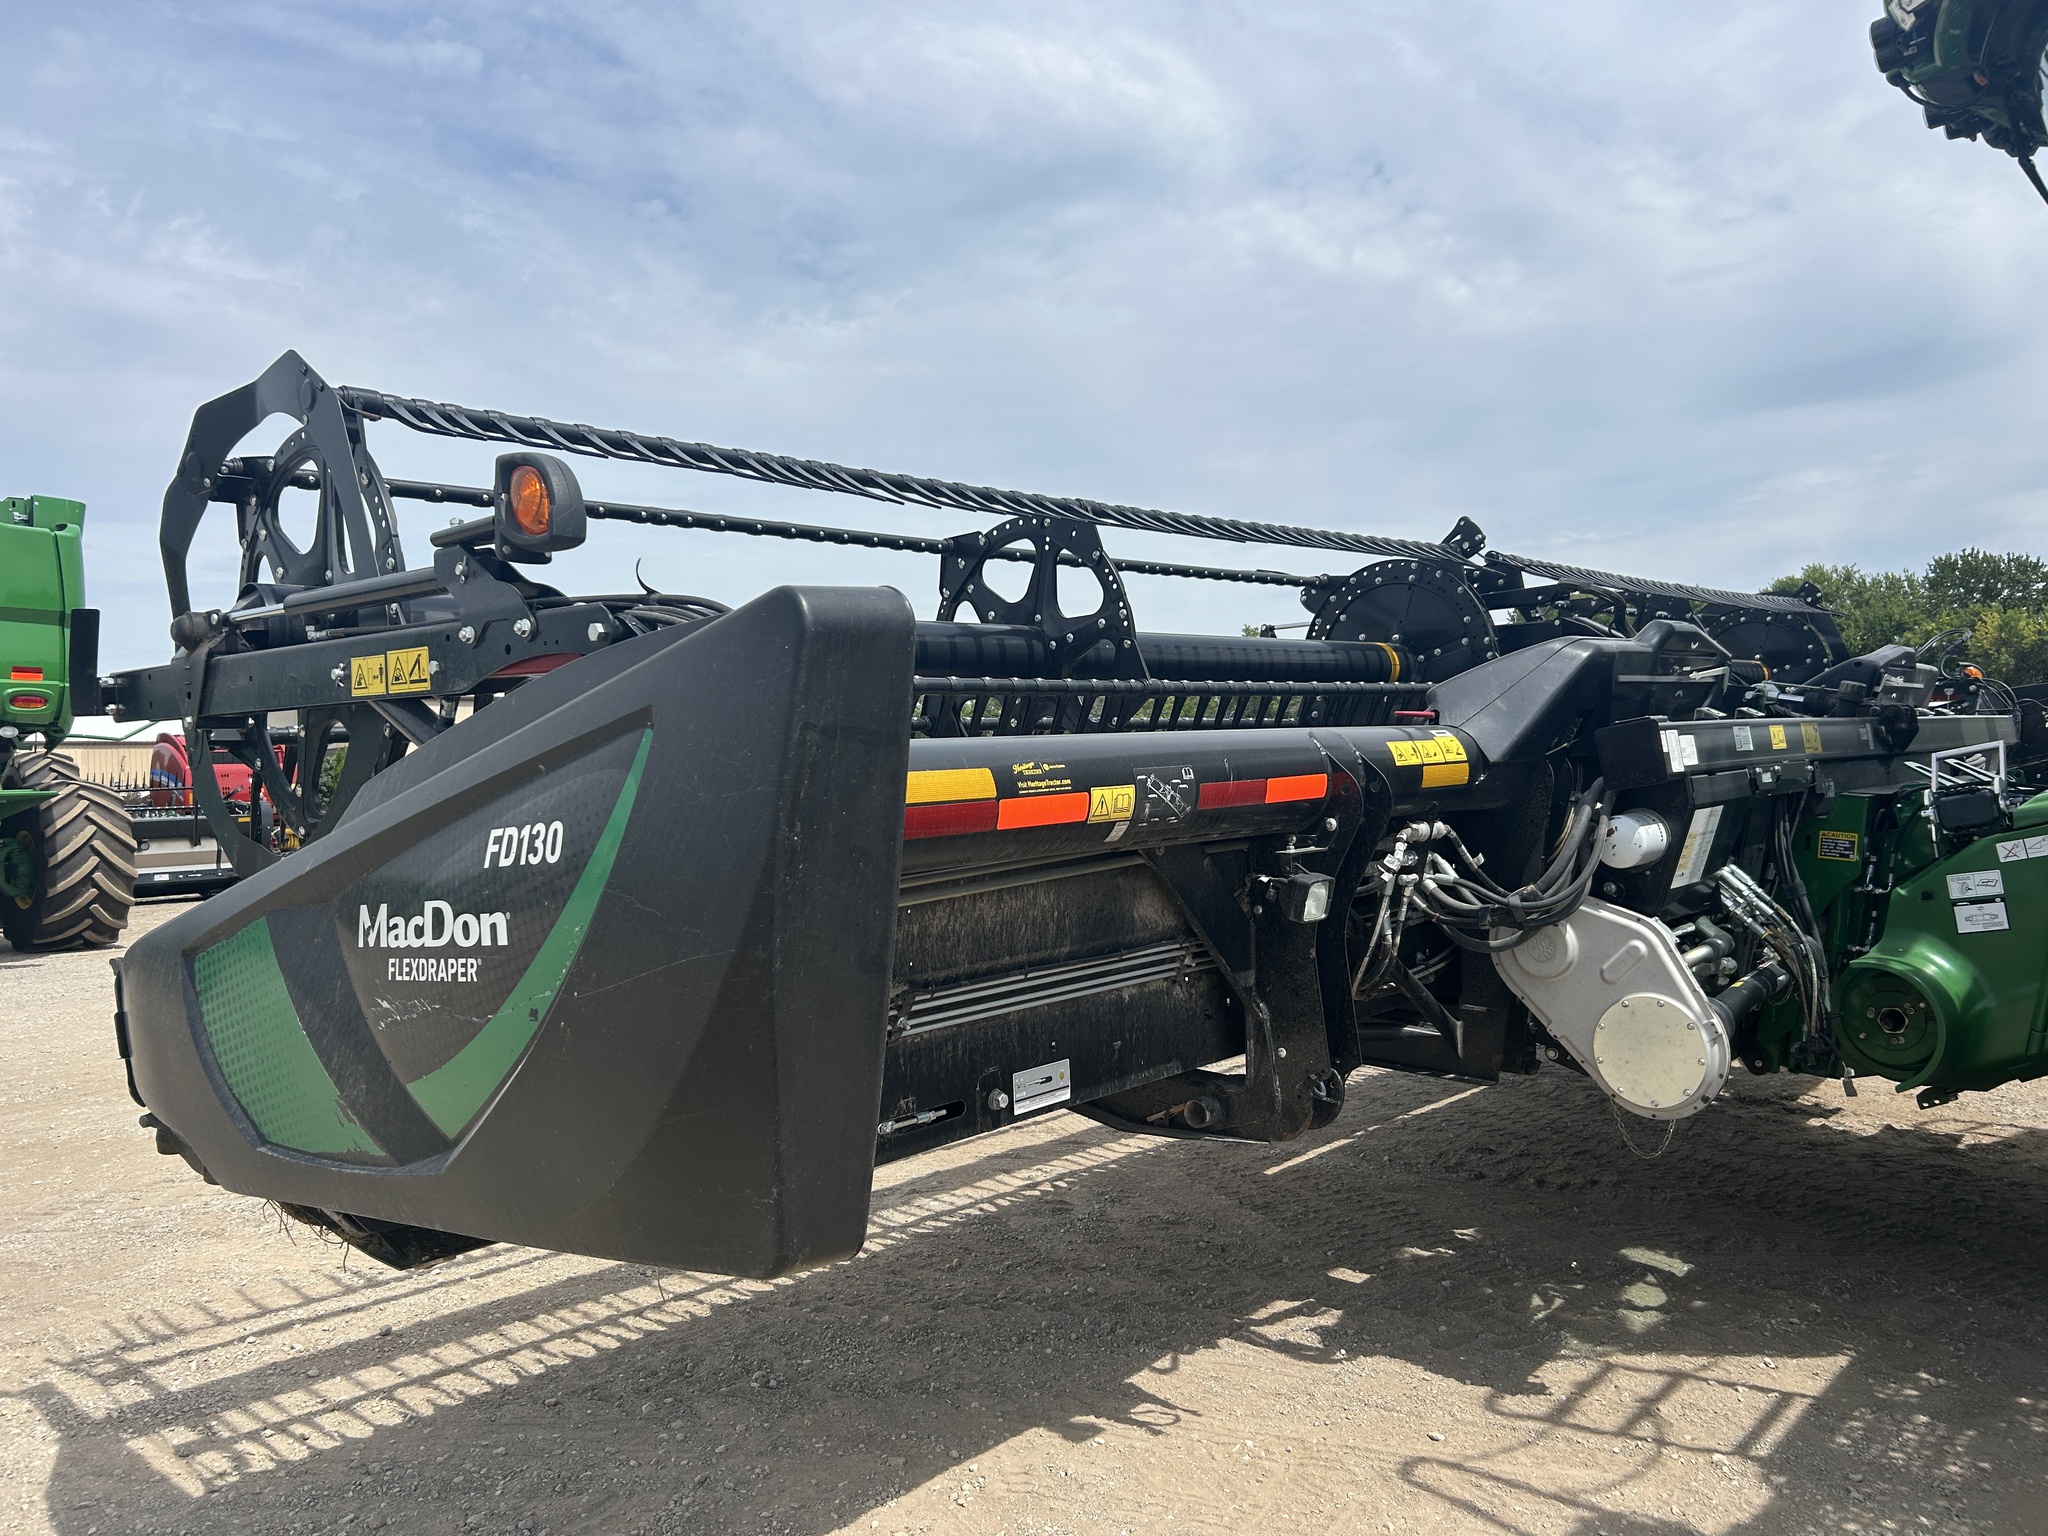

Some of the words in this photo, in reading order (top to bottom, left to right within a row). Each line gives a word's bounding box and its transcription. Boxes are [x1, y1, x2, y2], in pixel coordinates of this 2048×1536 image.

[484, 820, 564, 869] FD130
[358, 900, 509, 948] MacDon
[388, 957, 478, 982] FLEXDRAPER
